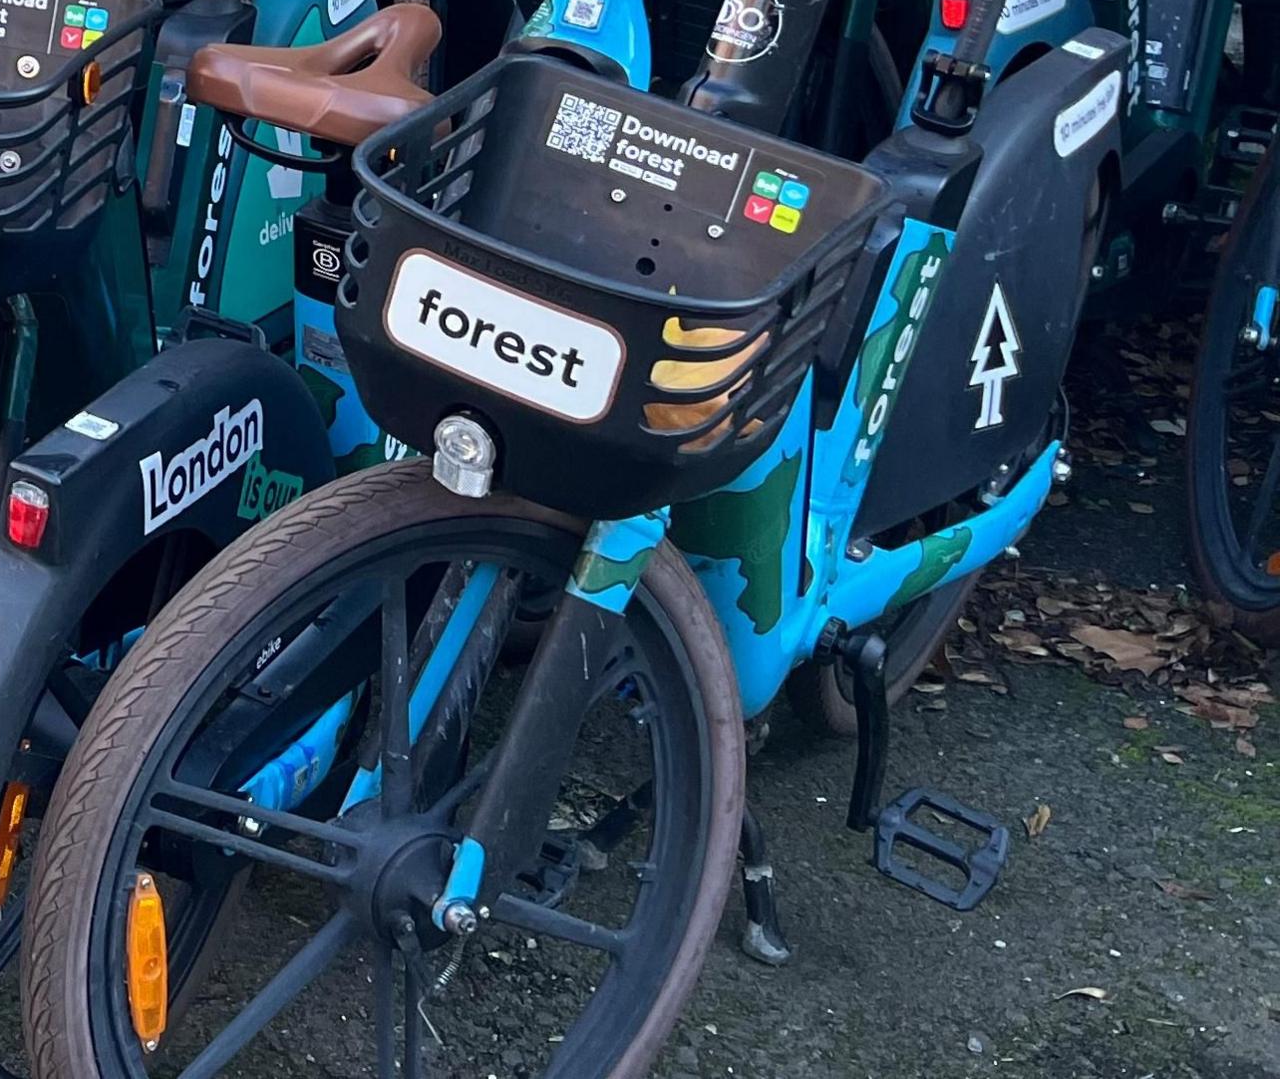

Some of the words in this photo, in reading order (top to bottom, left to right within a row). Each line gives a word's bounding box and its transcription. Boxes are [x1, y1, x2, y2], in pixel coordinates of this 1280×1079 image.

[615, 138, 686, 177] forest
[621, 114, 740, 172] Download
[417, 288, 585, 389] forest
[854, 255, 941, 468] forest
[148, 408, 260, 521] London
[243, 462, 261, 510] is
[255, 636, 282, 670] ebike
